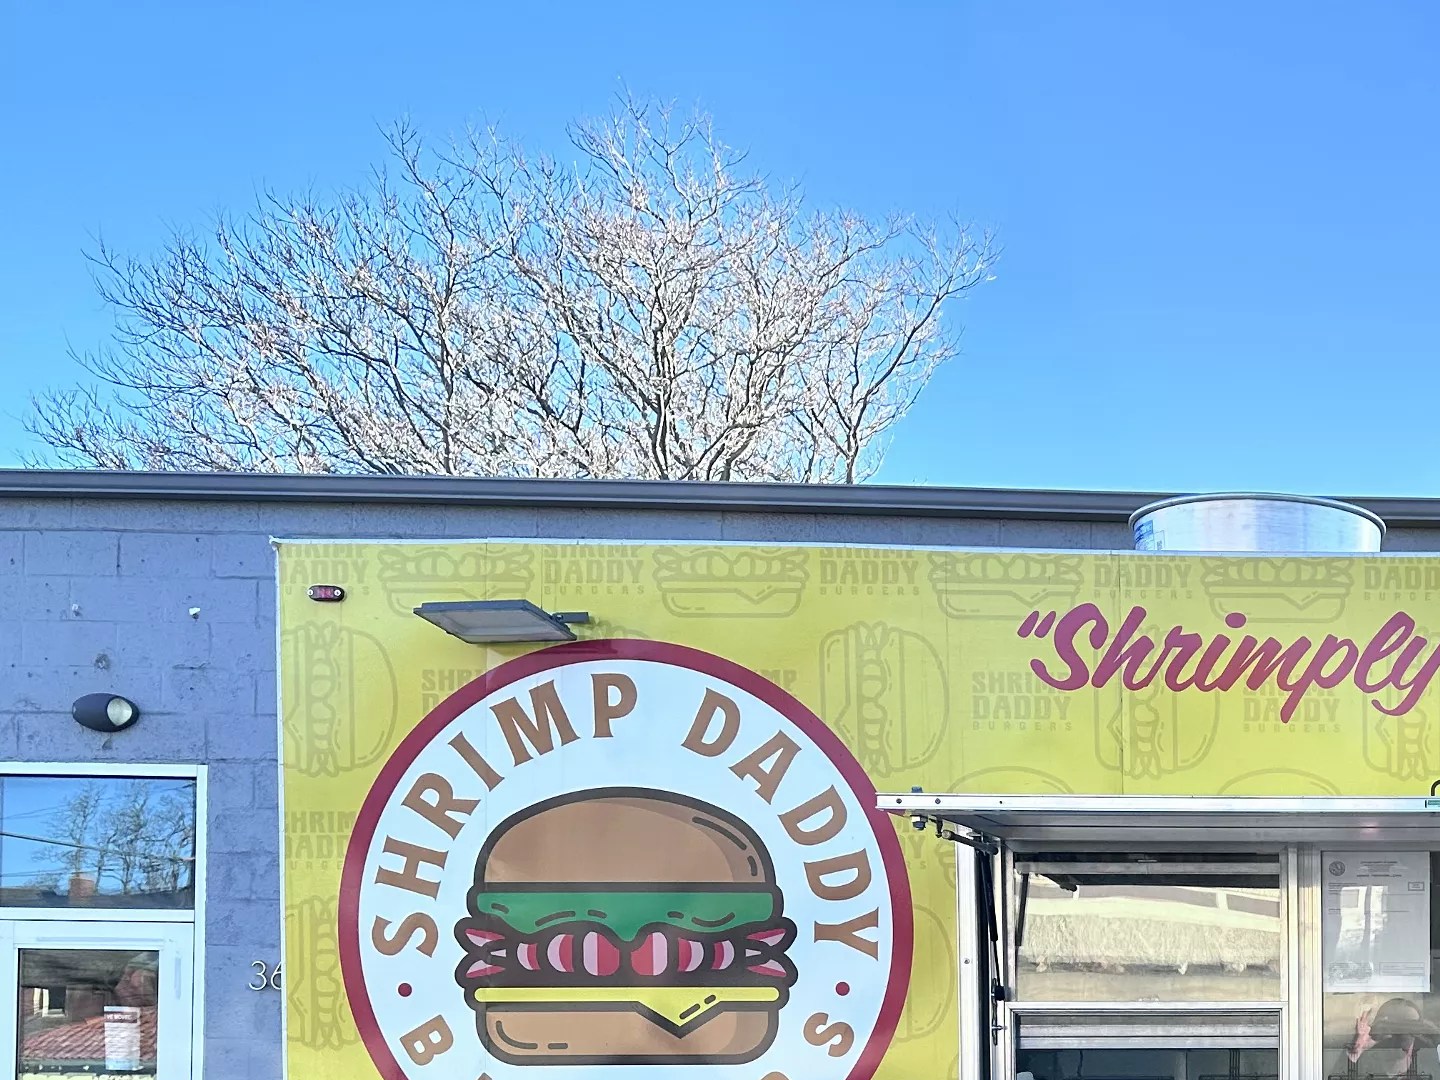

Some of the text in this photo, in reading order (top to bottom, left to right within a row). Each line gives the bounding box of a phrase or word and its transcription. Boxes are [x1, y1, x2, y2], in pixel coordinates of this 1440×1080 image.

[972, 695, 1071, 721] DADDY
[372, 673, 879, 961] SHRIMP DADDY
